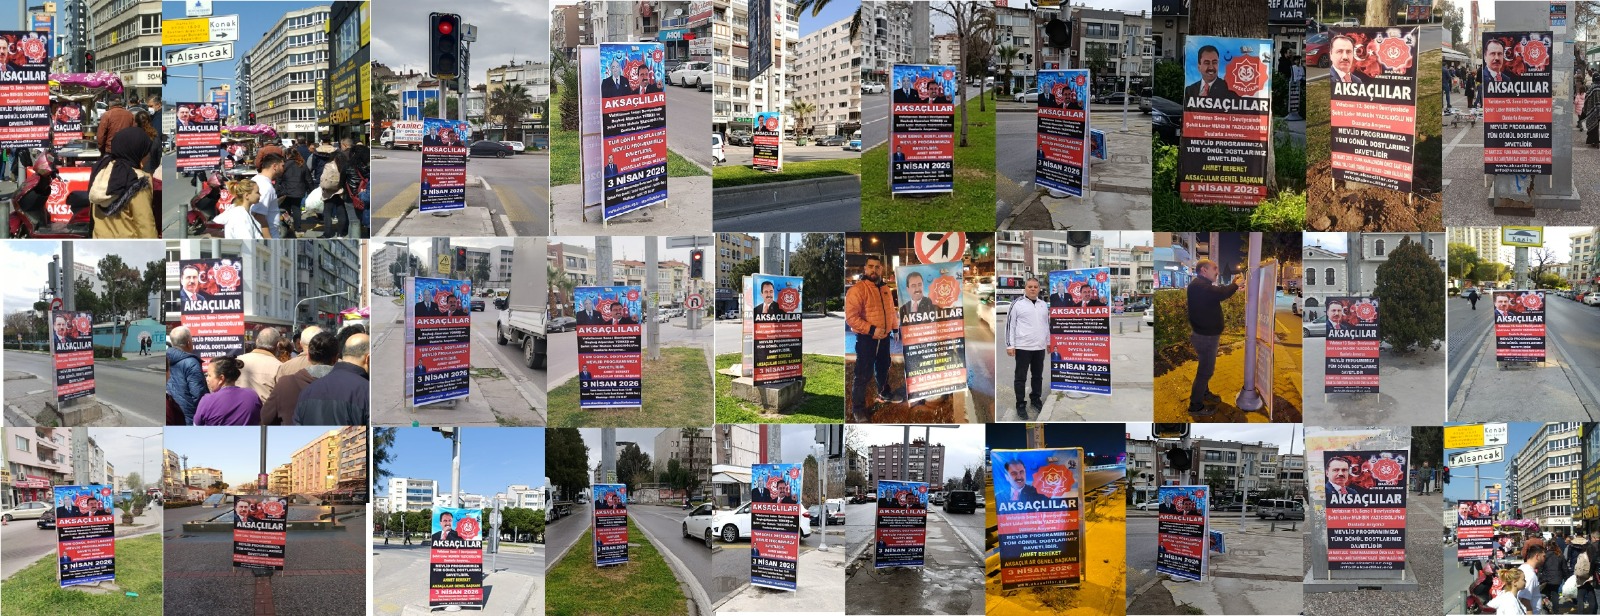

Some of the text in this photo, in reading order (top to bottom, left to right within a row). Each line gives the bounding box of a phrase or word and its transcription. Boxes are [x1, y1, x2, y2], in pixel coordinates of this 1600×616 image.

[1280, 9, 1302, 18] HAİR
[210, 20, 236, 28] Konak
[666, 31, 680, 39] A101
[177, 47, 228, 61] Alsancak
[0, 71, 46, 83] KSAÇLILAR
[1334, 82, 1411, 101] AKSAÇLILAR
[1487, 82, 1549, 96] AKSAÇLILAR
[605, 94, 664, 108] AKSAÇLILAR
[1187, 97, 1268, 112] AKSAÇLILAR
[1038, 109, 1084, 118] AKSAÇLILAR
[54, 124, 80, 132] KSAÇLILAR
[1338, 128, 1406, 141] MEVLİD PROGRAMIMIZA
[1349, 138, 1368, 147] GÖNÜL
[1370, 141, 1410, 152] DOSTLARIMIZ
[1355, 148, 1388, 158] DAVETLİDİR
[1043, 161, 1062, 170] NİSAN
[1064, 167, 1080, 175] 2026
[608, 166, 665, 188] 3 NİSAN 2026
[1185, 174, 1219, 182] AKSAÇLILAR
[1198, 183, 1230, 192] NİSAN
[1234, 186, 1259, 194] 2026
[184, 299, 240, 312] AKSAÇLILAR
[756, 314, 801, 322] AKSAÇLILAR
[903, 308, 963, 323] AKSAÇLILAR
[1497, 315, 1542, 323] AKSAÇLILAR
[579, 326, 639, 334] AKSAÇLILAR
[1328, 330, 1376, 339] AKSAÇLILAR
[57, 342, 92, 351] AKSAÇLILAR
[425, 372, 449, 381] NİSAN
[918, 373, 942, 382] NİSAN
[1458, 450, 1500, 464] Alsancak
[1330, 494, 1402, 507] AKSAÇLILAR
[753, 504, 798, 512] AKSAÇLILAR
[999, 500, 1076, 511] AKSAÇLILAR
[59, 516, 112, 524] AKSAÇLILAR
[237, 522, 283, 530] AKSAÇLILAR
[432, 541, 481, 549] AKSAÇLILAR
[1017, 566, 1047, 574] NİSAN
